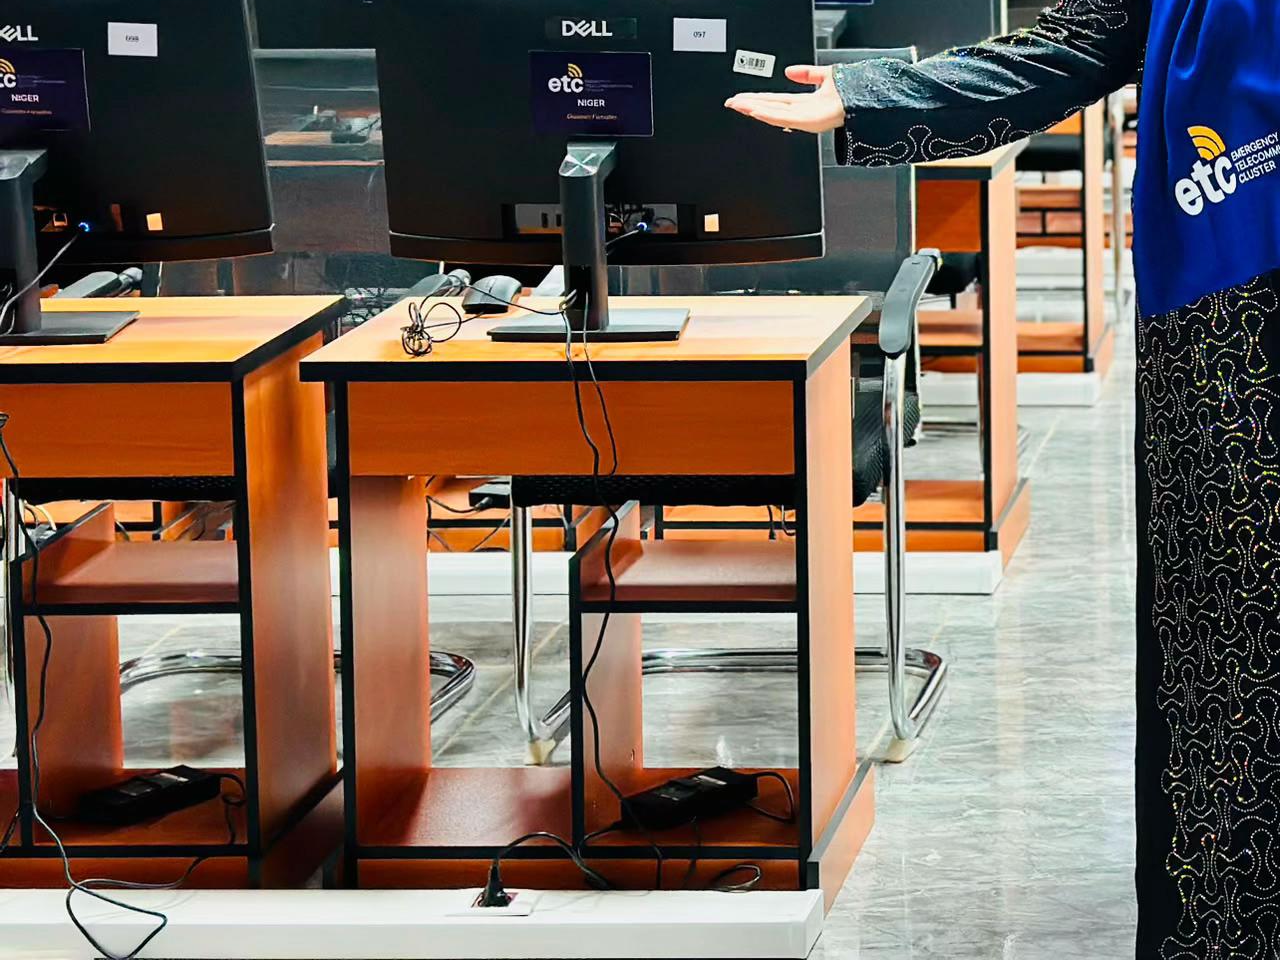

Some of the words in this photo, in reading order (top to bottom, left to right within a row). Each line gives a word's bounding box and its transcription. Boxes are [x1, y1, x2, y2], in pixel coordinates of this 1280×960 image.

[0, 25, 39, 42] ELL
[561, 20, 612, 37] DELL
[548, 74, 583, 93] etc
[11, 94, 39, 102] NIGER
[577, 99, 605, 107] NIGER
[1230, 132, 1279, 161] EMERGENCY
[1238, 161, 1277, 184] CLUSTER
[1174, 155, 1237, 216] etc
